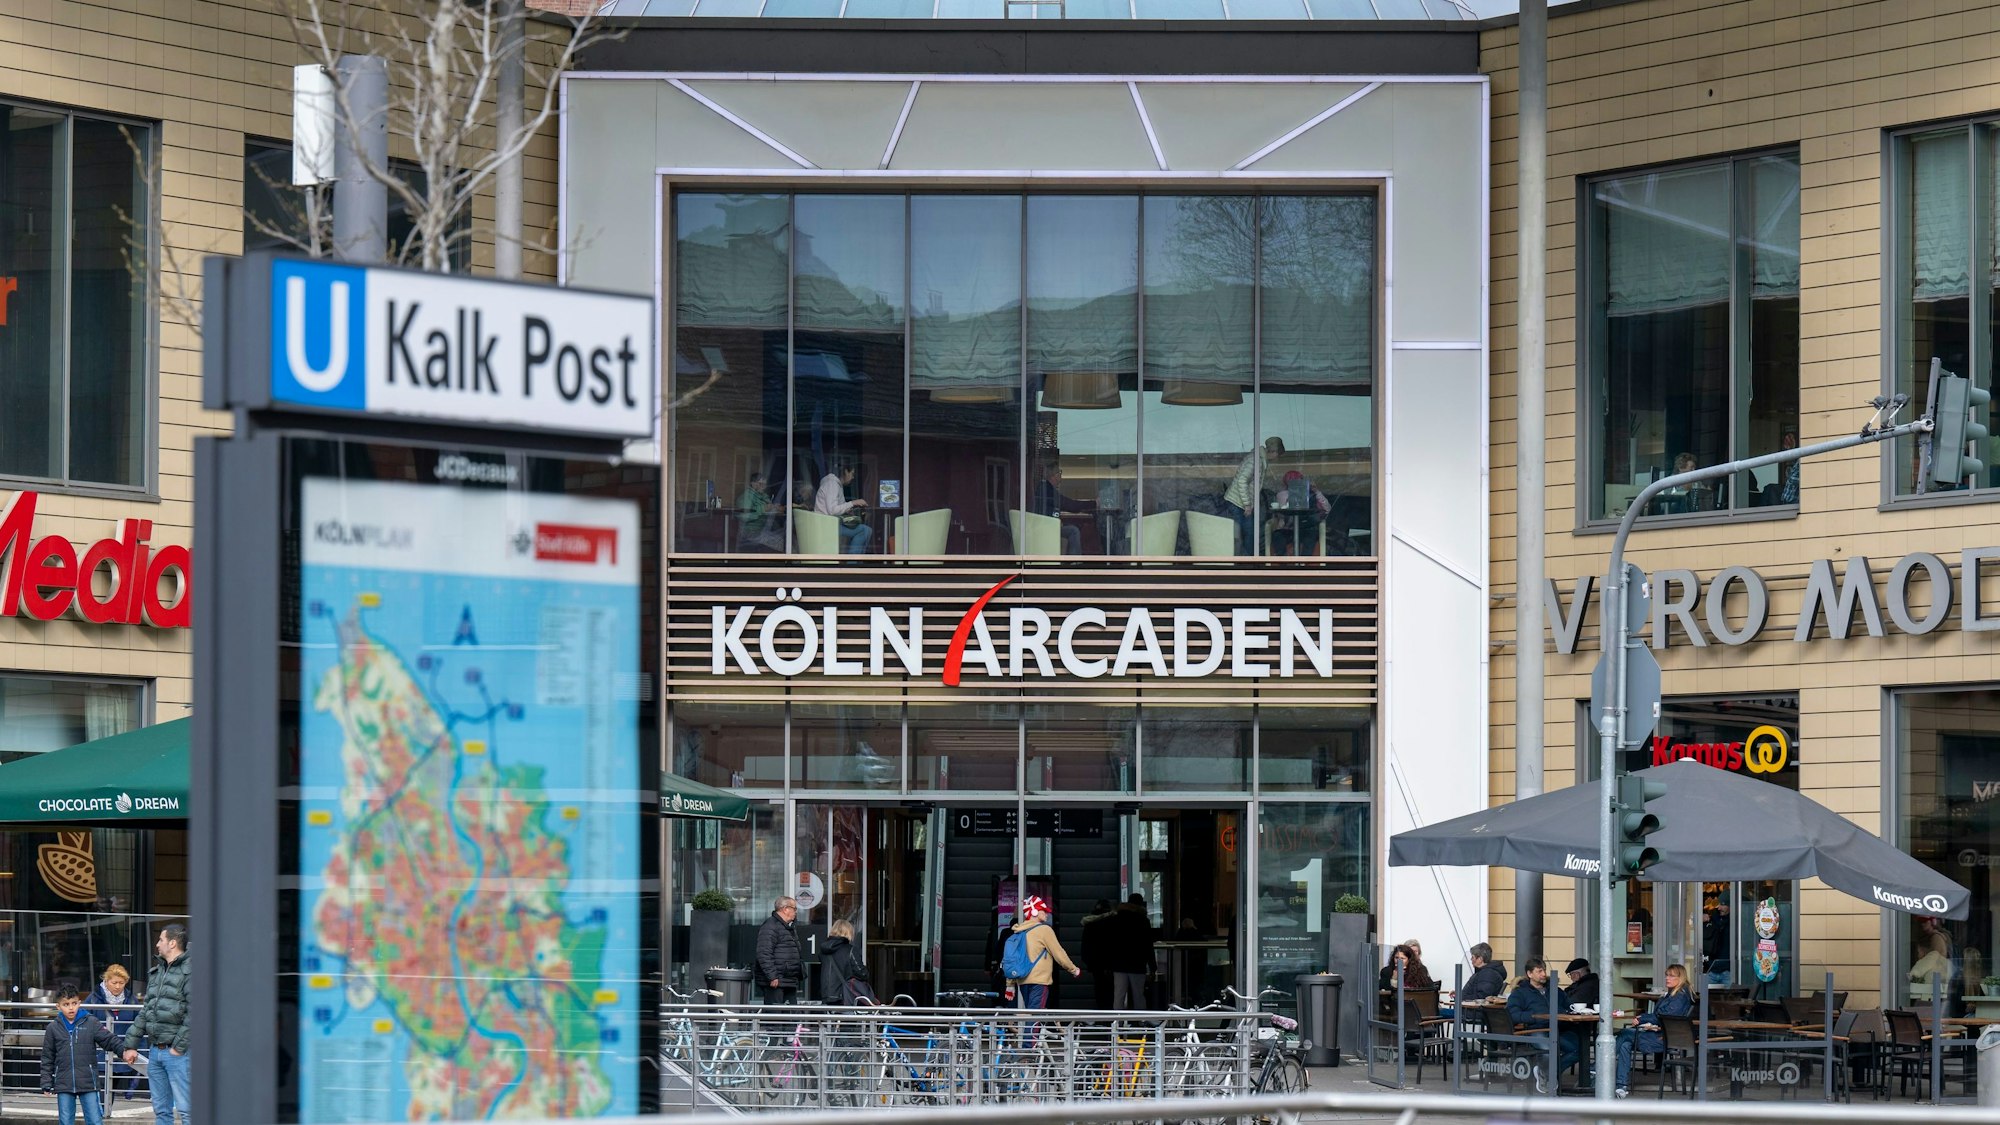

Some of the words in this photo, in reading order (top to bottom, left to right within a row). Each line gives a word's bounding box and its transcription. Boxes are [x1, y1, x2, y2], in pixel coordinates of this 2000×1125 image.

[286, 275, 350, 393] U
[385, 297, 502, 396] Kalk
[521, 314, 639, 409] Post
[1544, 564, 1769, 655] VRO
[711, 586, 923, 677] KÖLN
[943, 573, 1333, 687] ARCADEN
[1653, 735, 1743, 771] Kamps
[38, 797, 113, 812] CHOCOLATE
[135, 797, 179, 810] DREAM
[683, 798, 713, 812] DREAM
[960, 814, 970, 829] 0
[1564, 853, 1602, 875] Kamps
[1290, 858, 1323, 933] 1
[1872, 885, 1924, 911] Kamps
[807, 934, 816, 955] 1
[1478, 1057, 1512, 1076] Kamps
[1731, 1067, 1775, 1085] Kamps
